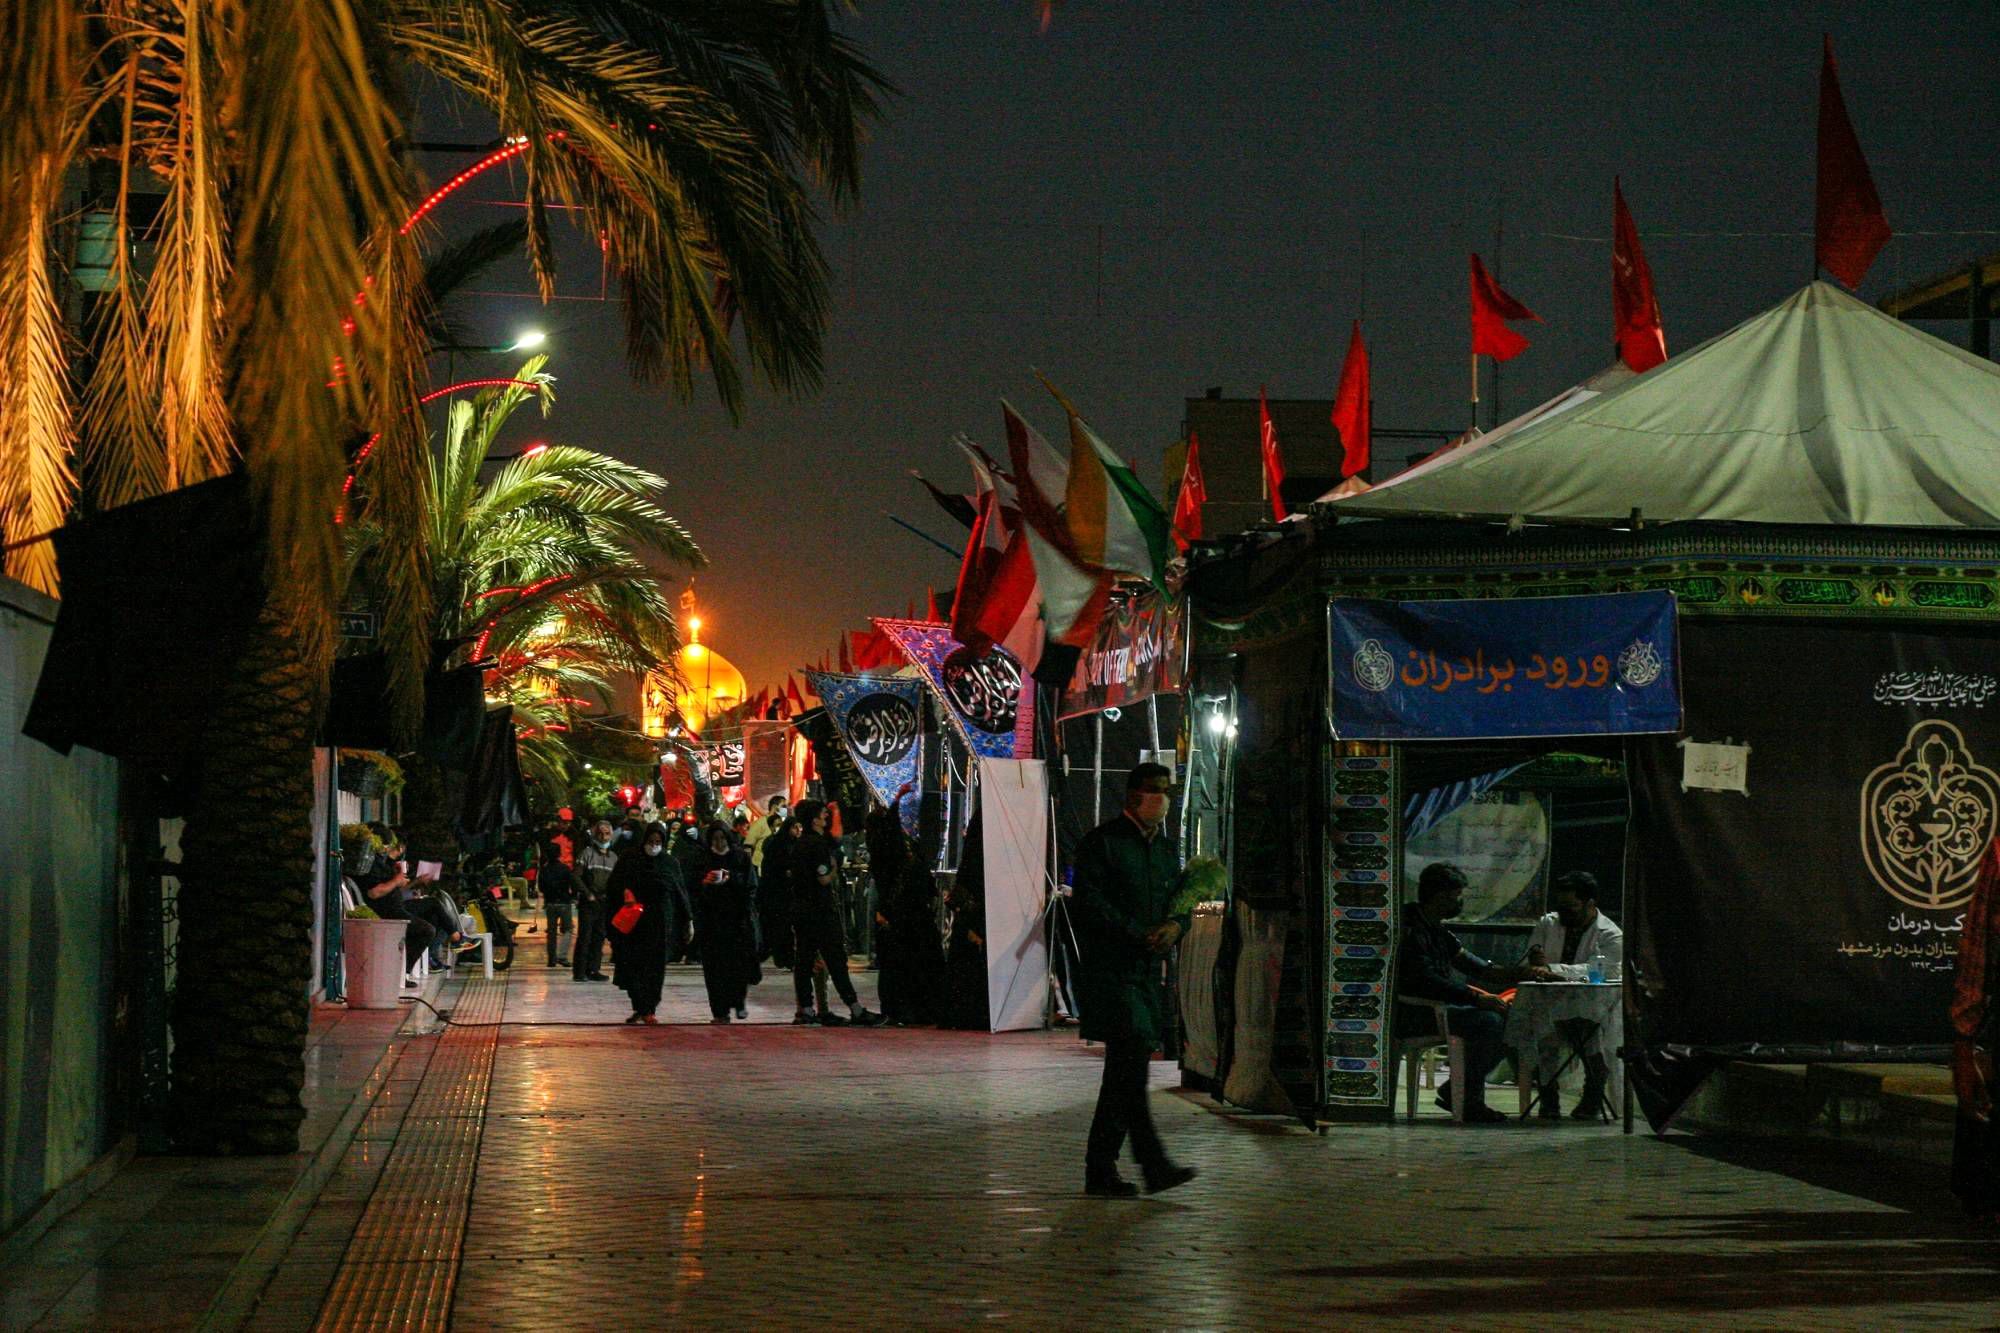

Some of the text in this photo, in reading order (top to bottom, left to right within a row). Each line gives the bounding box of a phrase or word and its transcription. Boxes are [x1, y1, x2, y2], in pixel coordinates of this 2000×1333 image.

[1400, 649, 1516, 694] برادران
[1526, 652, 1611, 689] ورود
[1888, 912, 1967, 937] کب درمان
[1836, 941, 1959, 958] ستاران بدون مرز مشهد
